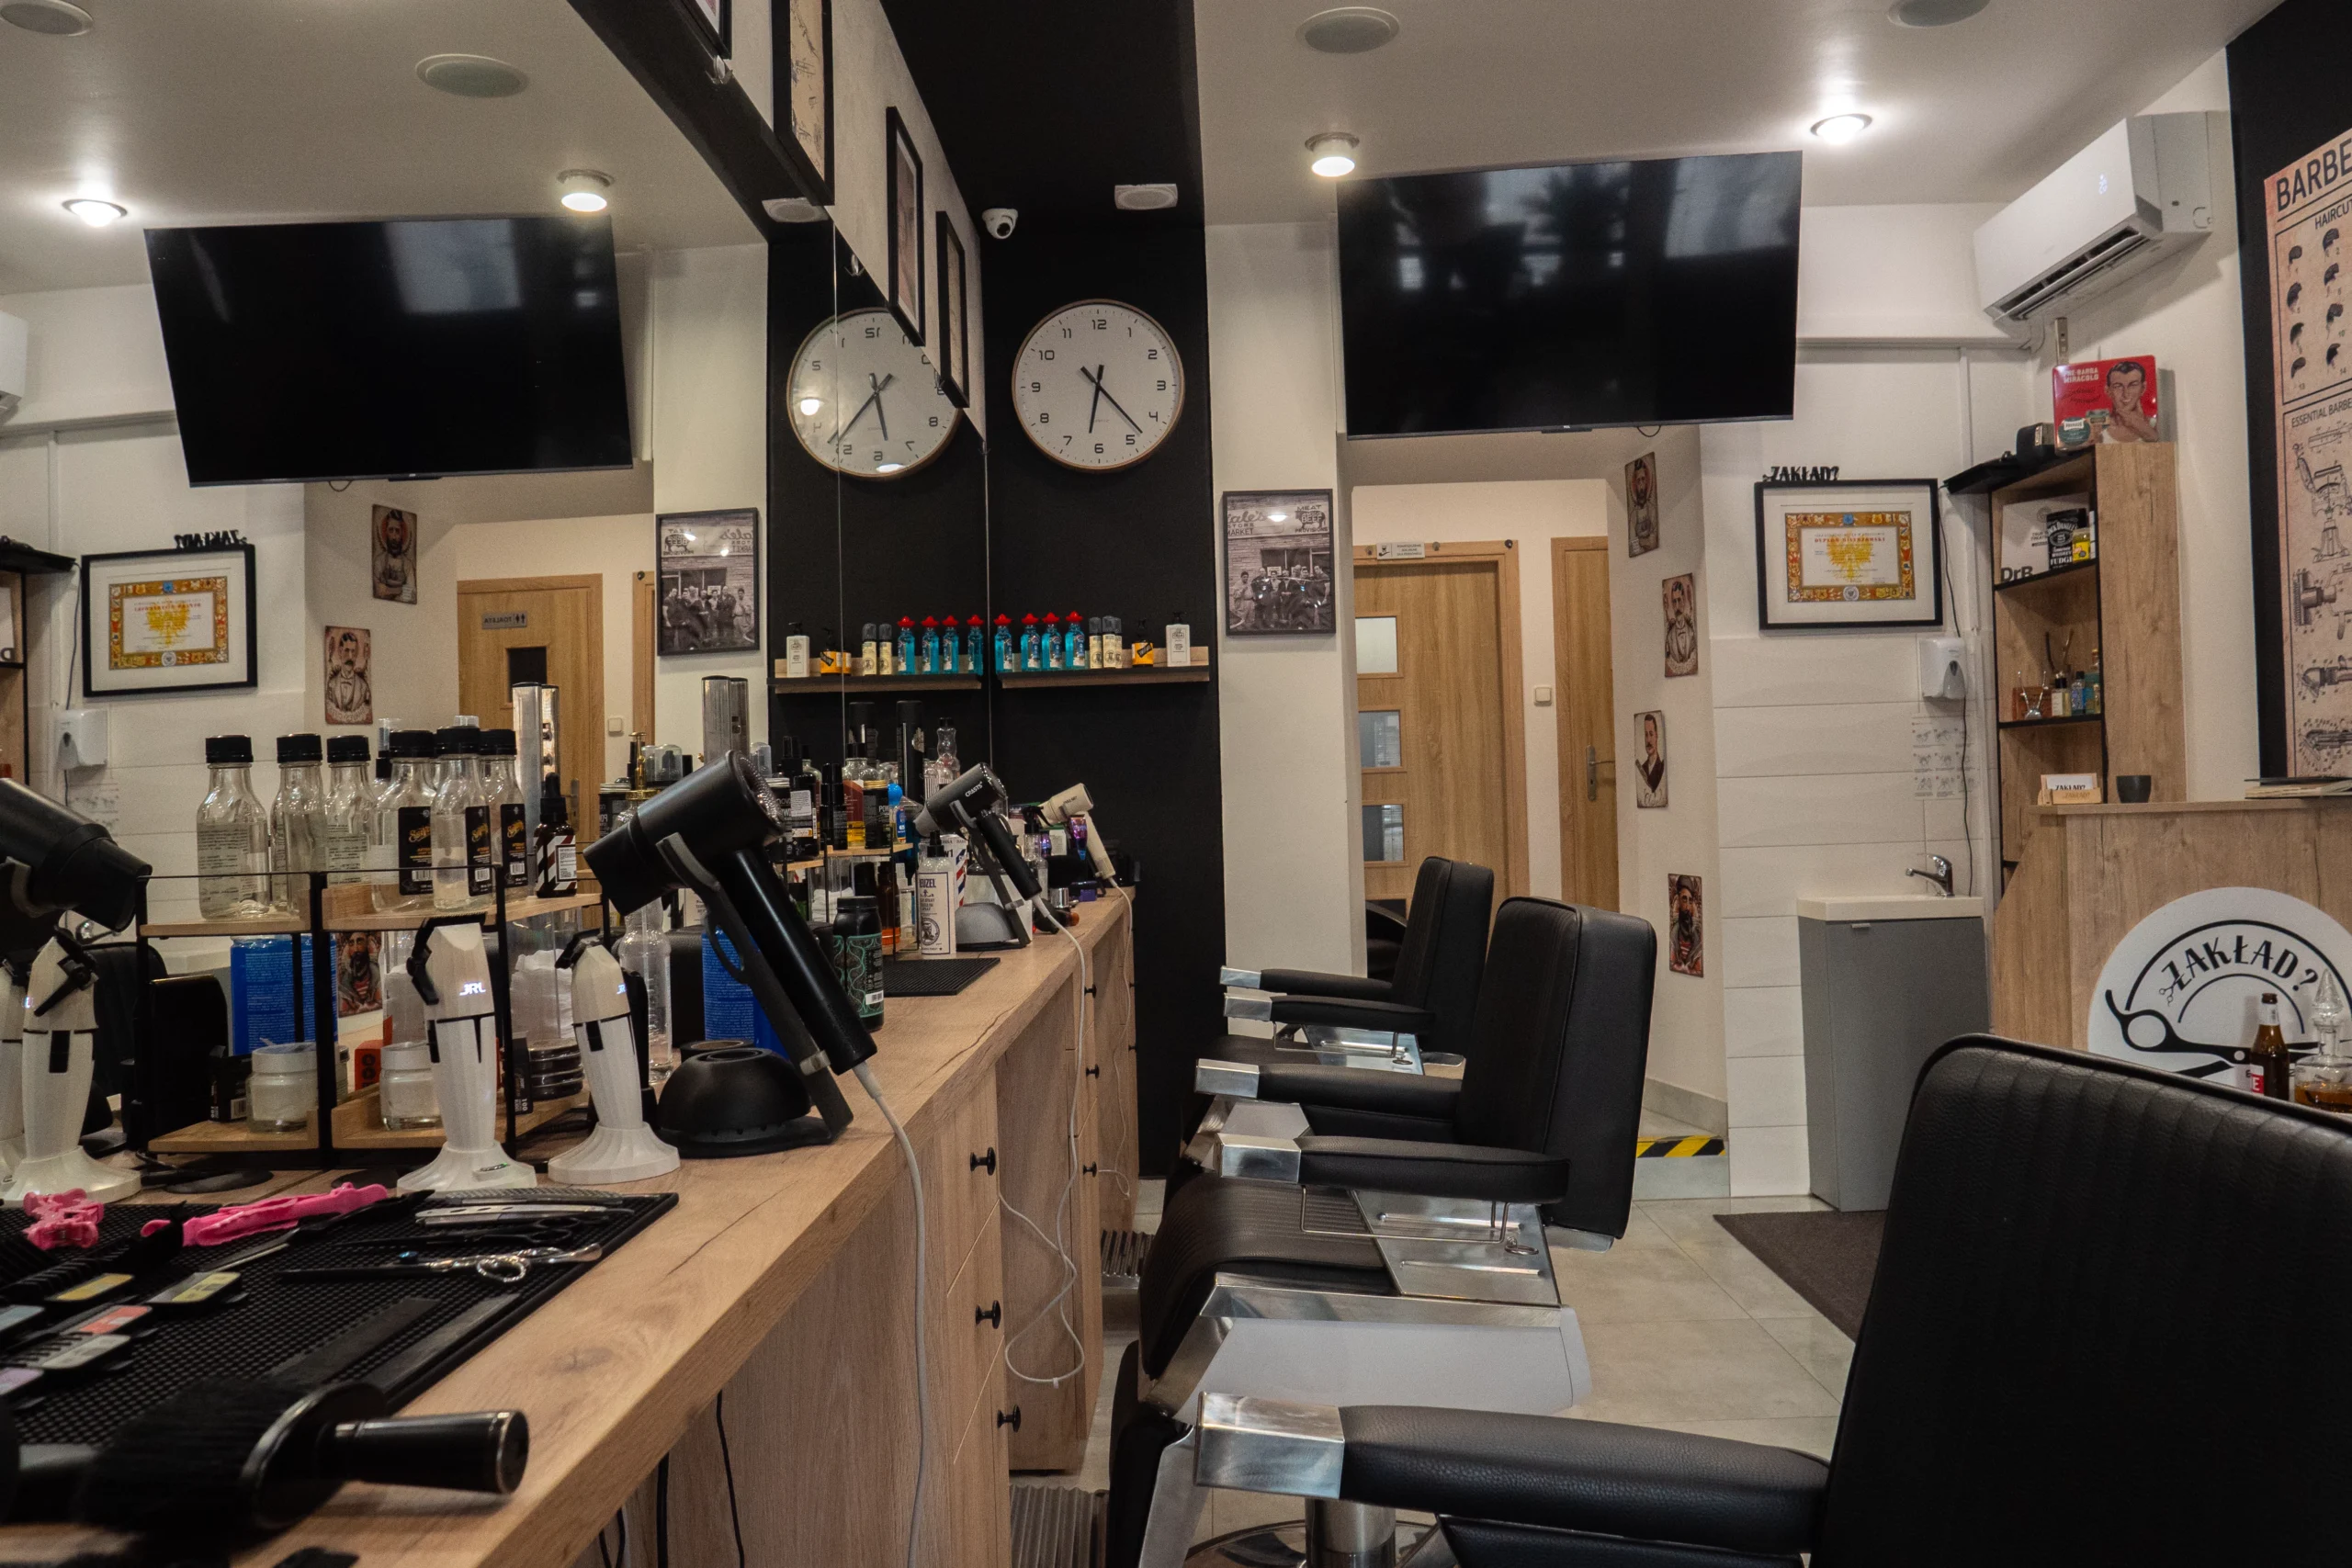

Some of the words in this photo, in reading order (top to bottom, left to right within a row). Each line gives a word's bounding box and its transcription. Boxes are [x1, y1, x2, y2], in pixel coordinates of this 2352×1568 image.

[2276, 138, 2352, 212] BARBE
[1091, 319, 1107, 330] 12
[1062, 328, 1072, 339] 11
[1127, 327, 1133, 338] 1
[1038, 350, 1055, 361] 10
[1148, 349, 1158, 360] 2
[1031, 381, 1041, 392] 9
[1157, 379, 1167, 390] 3
[1040, 412, 1049, 423] 8
[1148, 411, 1159, 423] 4
[2291, 407, 2327, 428] ESSENTIAL
[1063, 434, 1073, 446] 7
[1125, 434, 1136, 446] 5
[1094, 443, 1104, 454] 6
[919, 878, 936, 888] EUZEL
[2161, 935, 2319, 991] ZAKŁAD?
[459, 982, 486, 996] JRL
